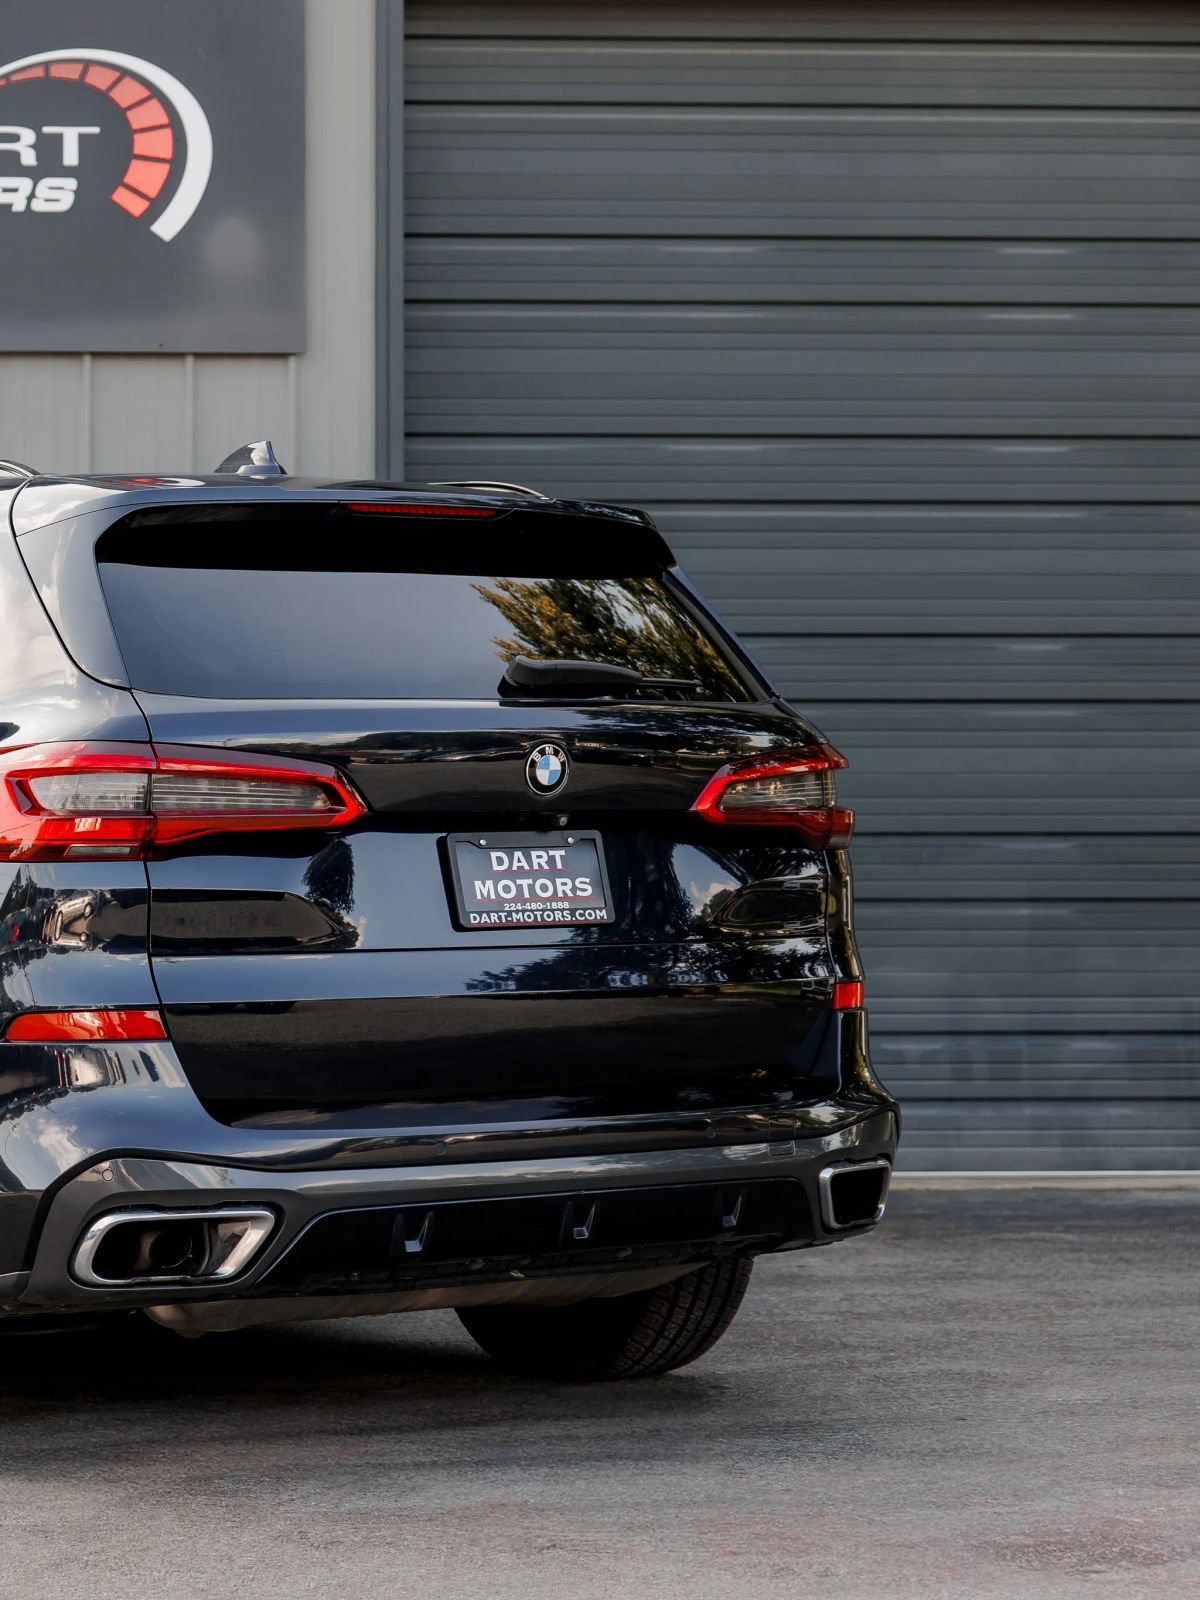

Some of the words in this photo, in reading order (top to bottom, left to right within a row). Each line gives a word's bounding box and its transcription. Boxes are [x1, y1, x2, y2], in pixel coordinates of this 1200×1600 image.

[532, 746, 565, 762] BMW
[490, 850, 566, 871] DART
[473, 877, 593, 900] MOTORS
[503, 901, 570, 911] 224-480-1888
[469, 909, 608, 924] DART-MOTORS.COM
